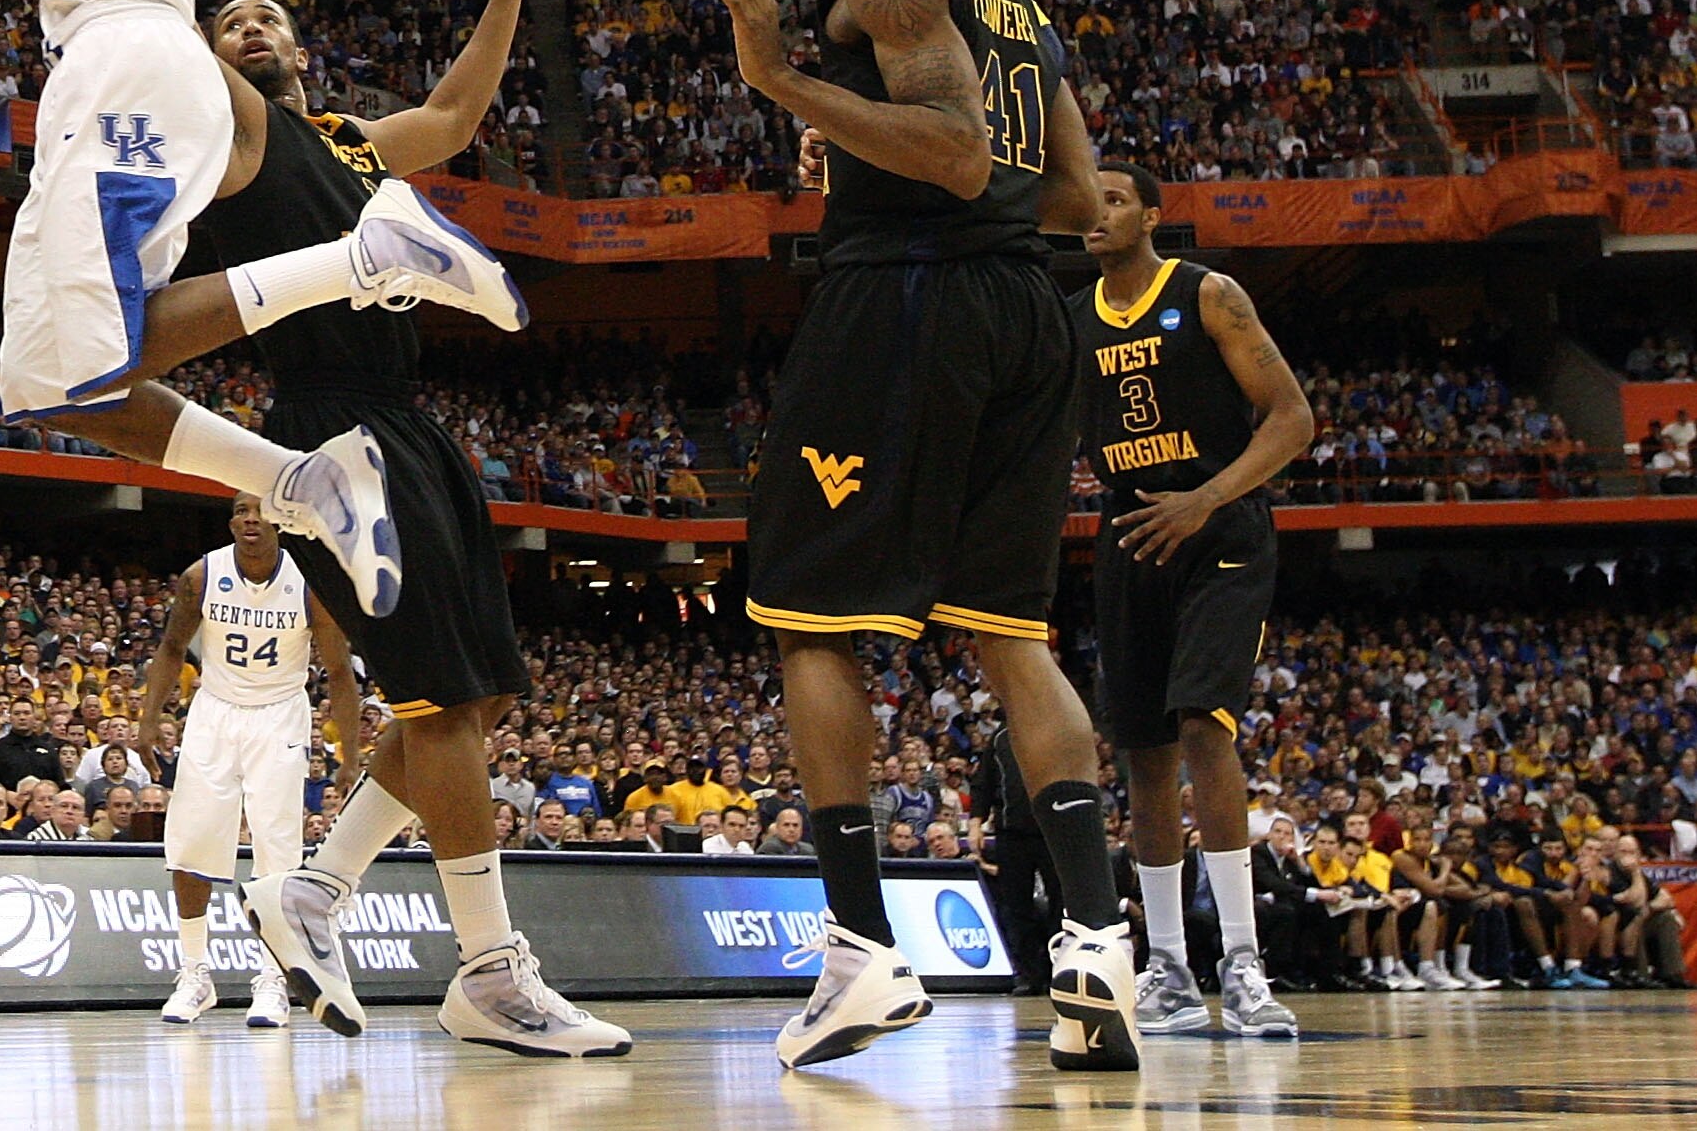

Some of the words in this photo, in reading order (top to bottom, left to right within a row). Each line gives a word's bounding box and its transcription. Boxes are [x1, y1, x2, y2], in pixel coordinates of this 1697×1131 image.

[1461, 72, 1489, 90] 314
[981, 49, 1045, 174] 41
[97, 112, 166, 168] UK
[504, 198, 539, 218] NCAA
[1214, 194, 1267, 209] NCAA
[1351, 189, 1407, 205] NCAA
[578, 212, 628, 226] NCAA
[664, 209, 694, 224] 214
[1095, 335, 1162, 376] WEST
[1119, 374, 1161, 433] 3
[1102, 430, 1199, 474] VIRGINIA
[209, 603, 298, 629] KENTUCKY
[226, 633, 279, 668] 24
[704, 909, 772, 947] WEST
[946, 926, 989, 950] NCAA
[347, 938, 420, 969] YORK
